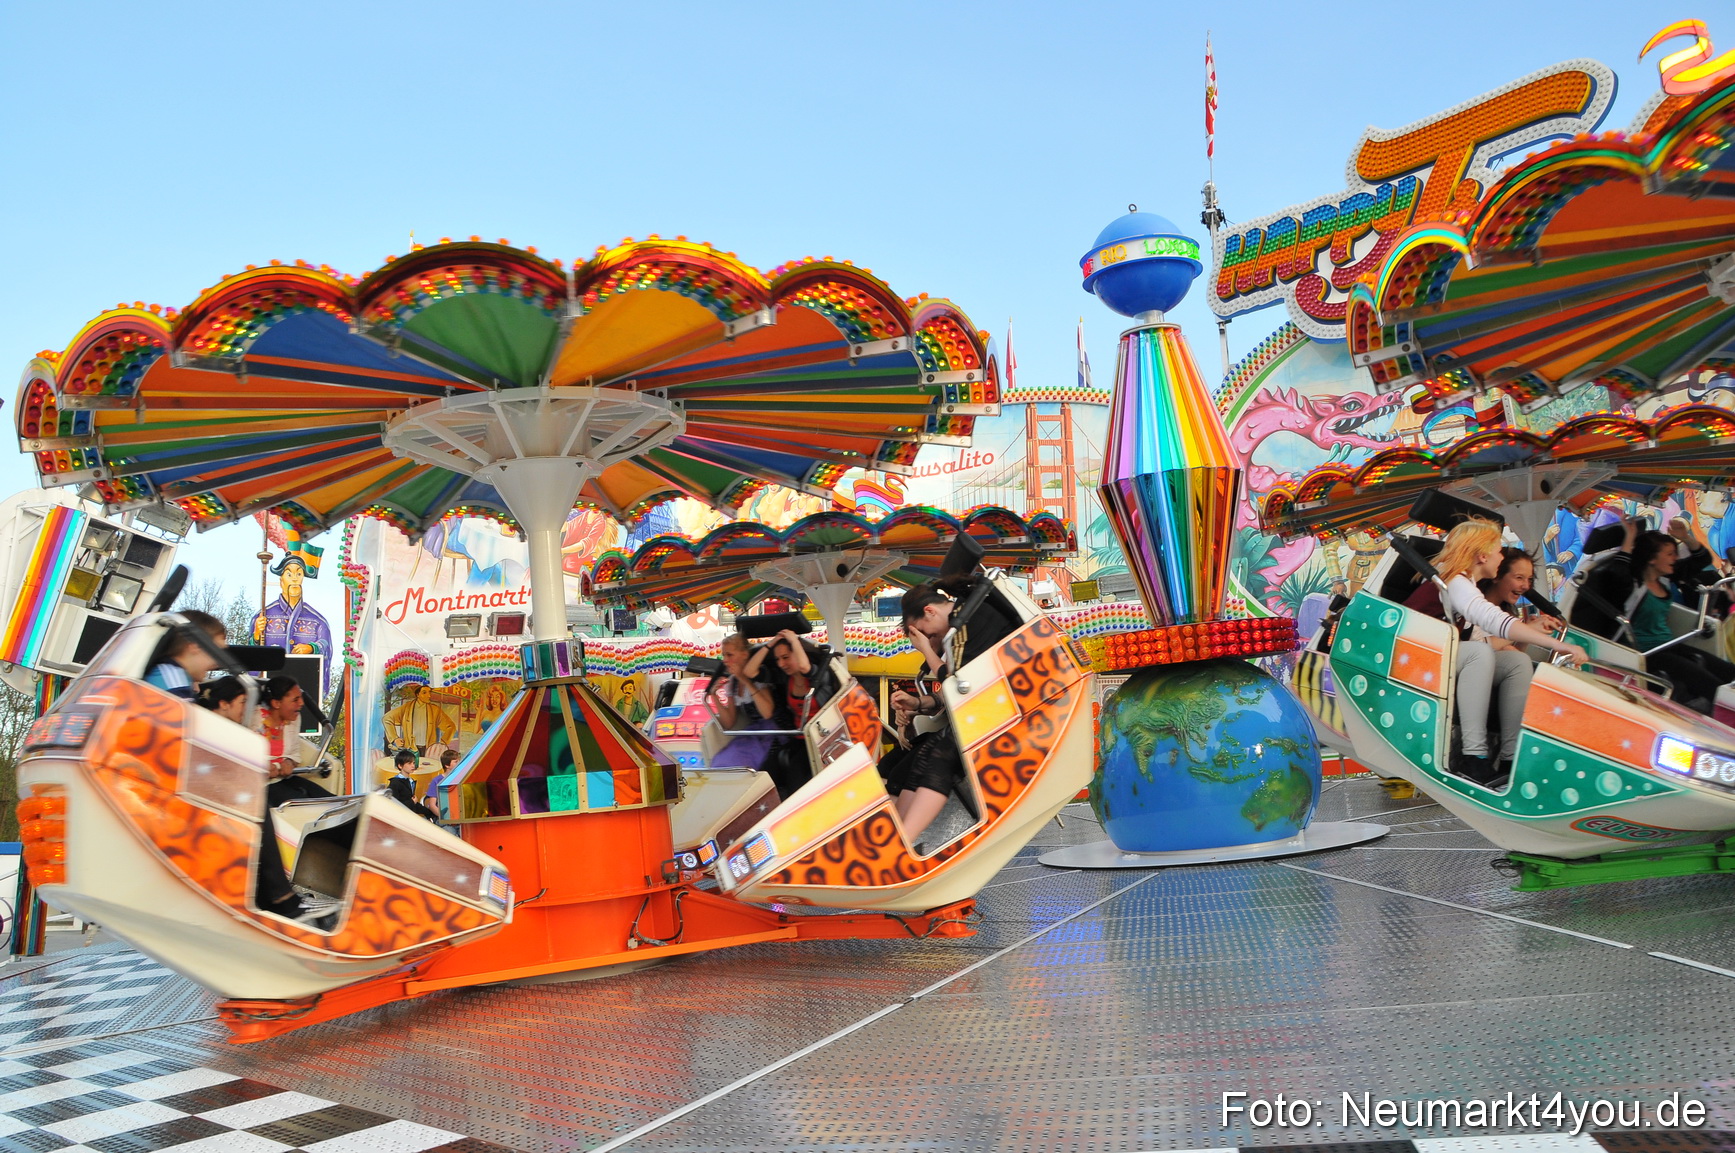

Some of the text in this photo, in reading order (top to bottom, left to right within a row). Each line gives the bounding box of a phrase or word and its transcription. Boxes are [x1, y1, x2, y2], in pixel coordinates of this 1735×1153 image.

[1099, 244, 1127, 266] RIO
[1216, 175, 1422, 319] HAPPY
[384, 585, 533, 625] Montmart
